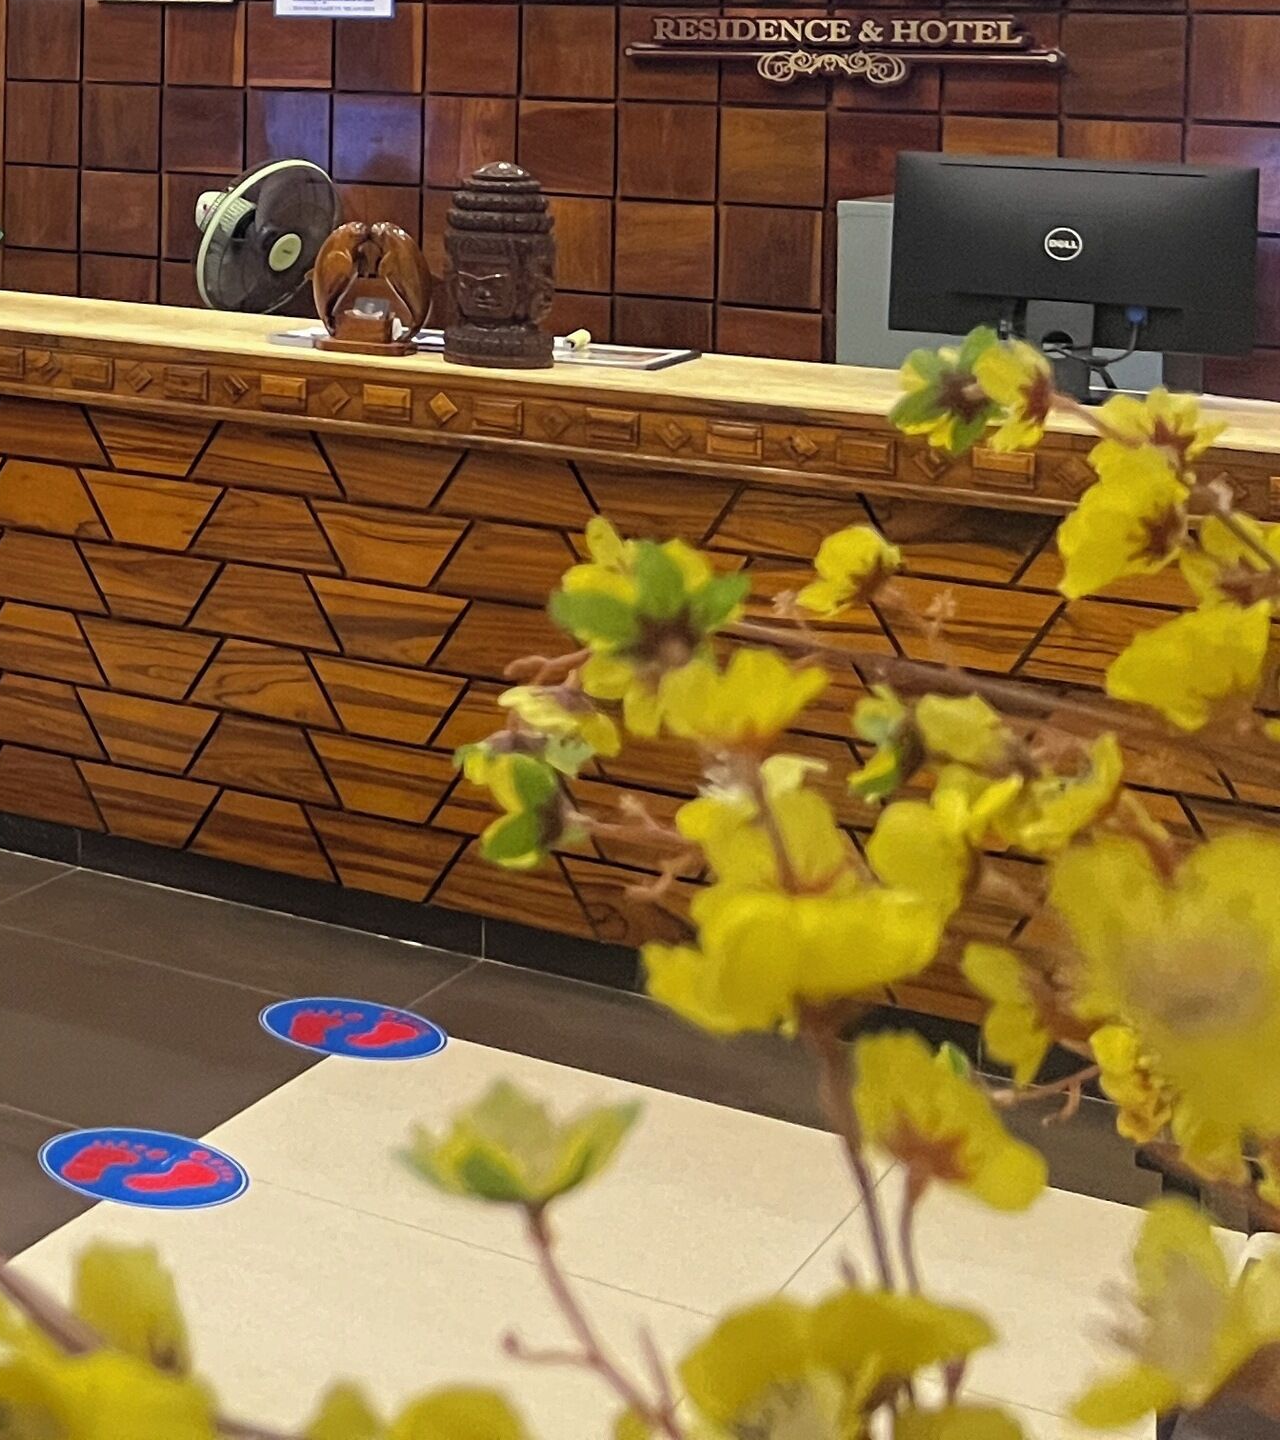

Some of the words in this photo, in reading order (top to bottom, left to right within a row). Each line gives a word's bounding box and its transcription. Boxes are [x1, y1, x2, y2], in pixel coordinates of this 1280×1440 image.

[653, 17, 851, 43] RESIDENCE
[858, 20, 882, 43] &
[890, 20, 1024, 45] HOTEL
